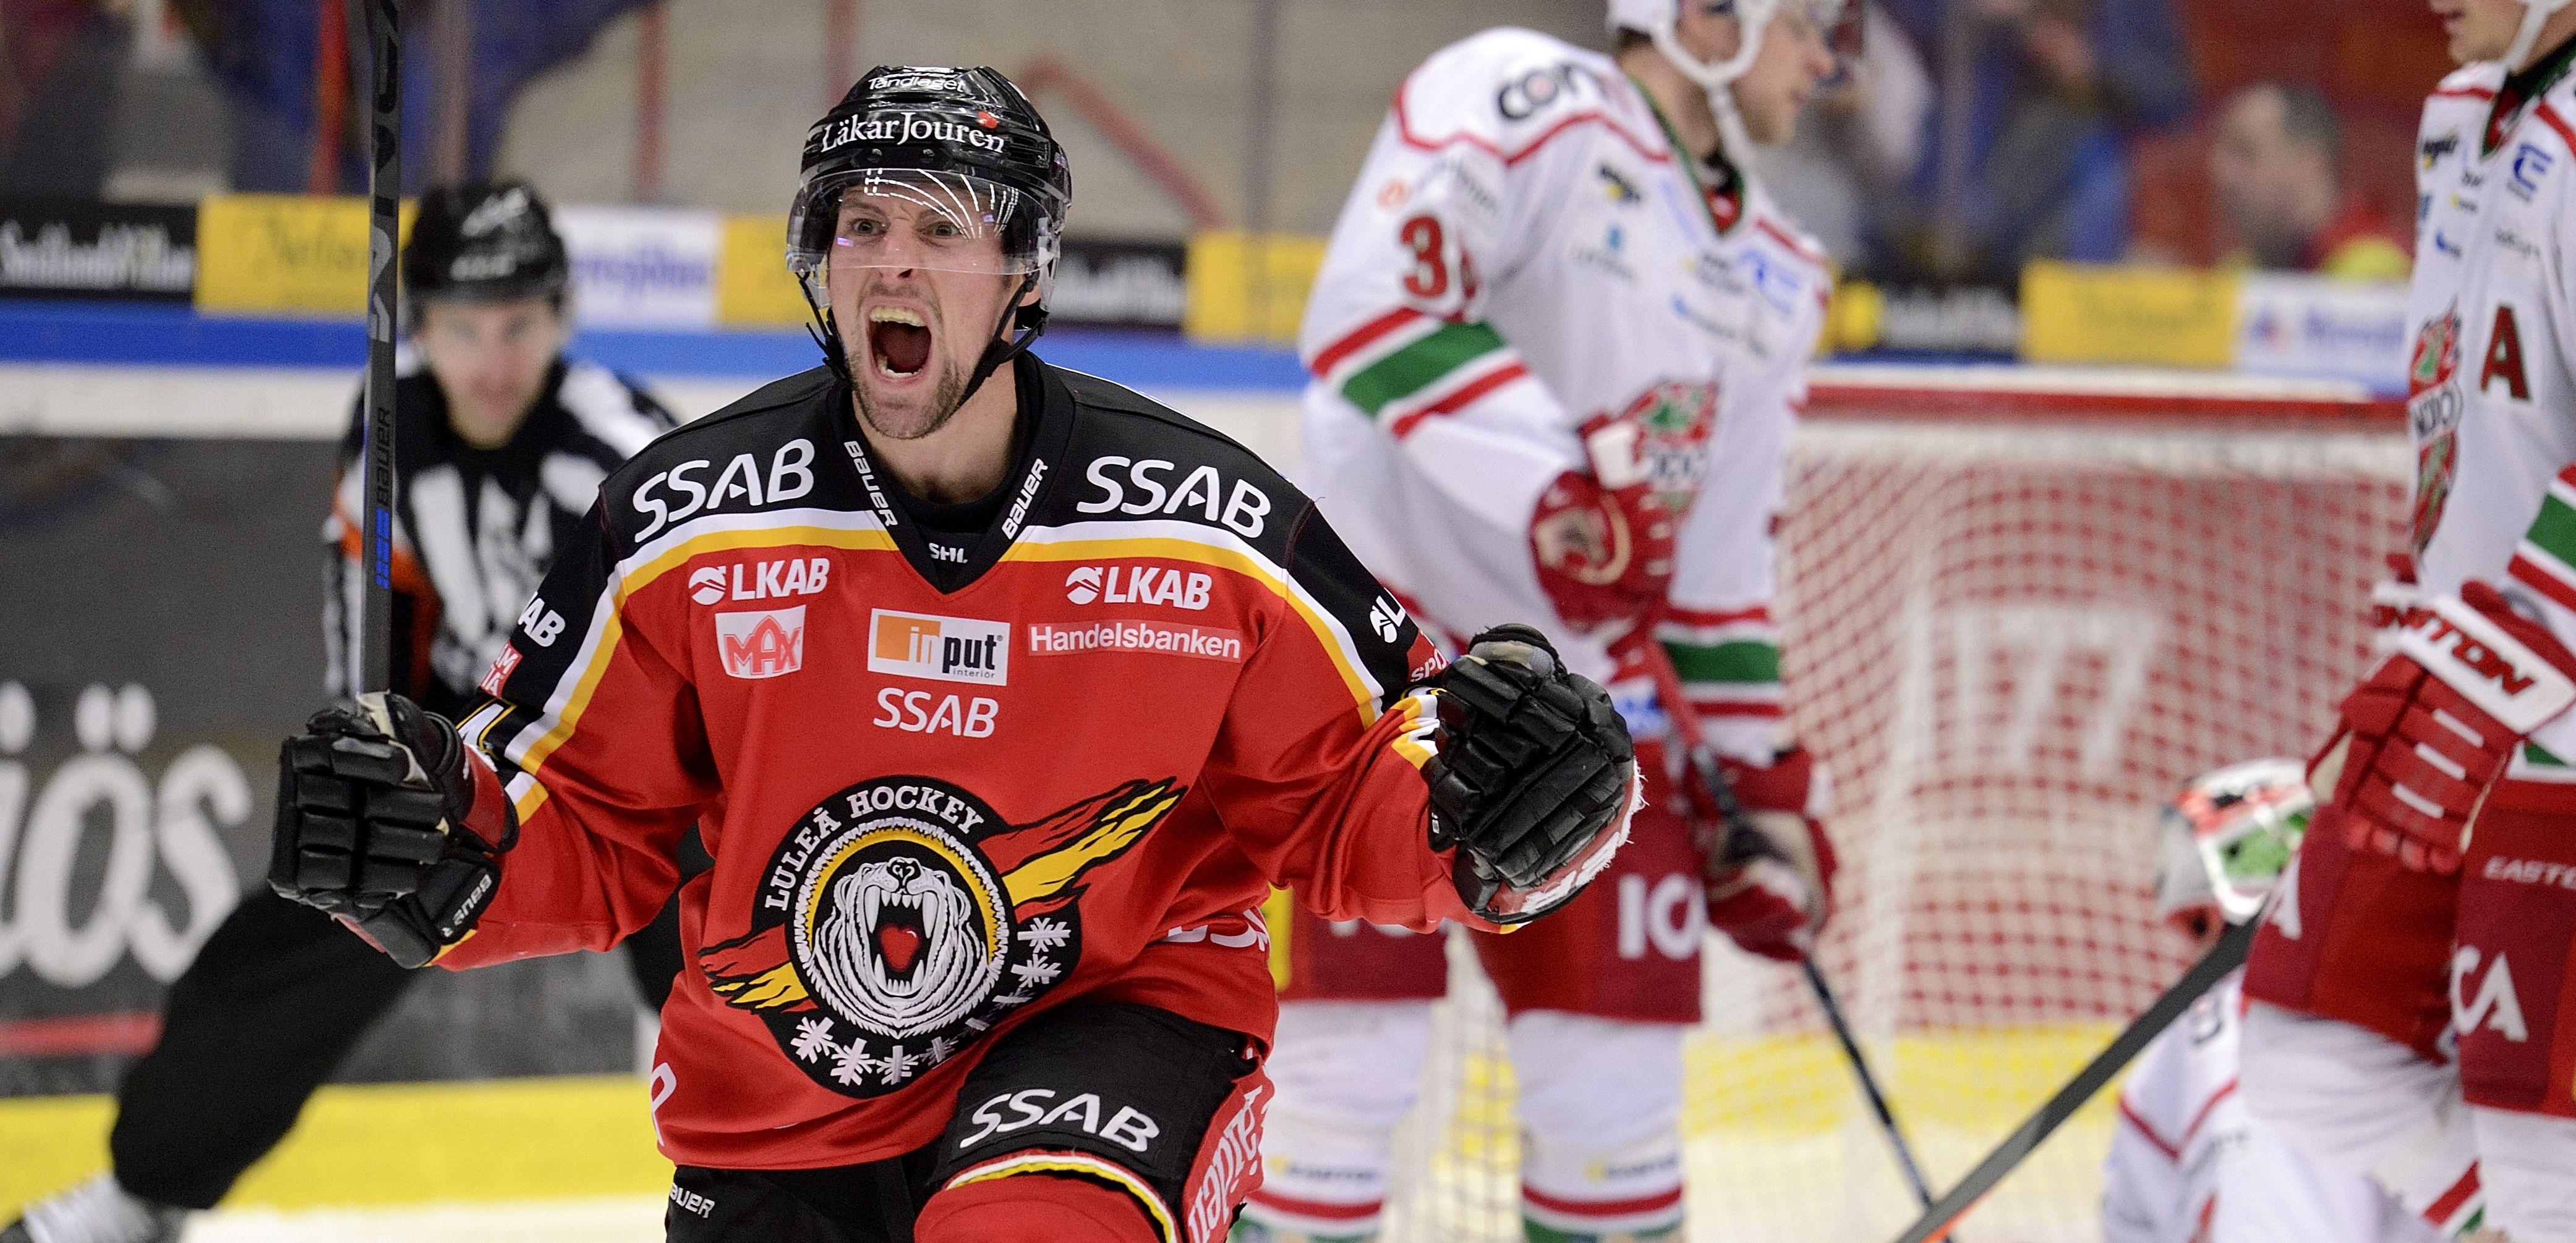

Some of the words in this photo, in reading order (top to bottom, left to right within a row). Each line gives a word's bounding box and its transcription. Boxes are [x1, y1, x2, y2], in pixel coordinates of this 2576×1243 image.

[821, 112, 1005, 154] LäkarJouren
[2480, 305, 2530, 401] A
[632, 438, 815, 543] SSAB
[843, 441, 898, 527] BAUER
[1001, 458, 1049, 540] BAUER
[1076, 456, 1271, 538] SSAB
[731, 558, 830, 601] LKAB
[928, 543, 968, 564] SHL
[1104, 566, 1213, 611] LKAB
[517, 590, 566, 647] AB
[724, 615, 802, 676] MAX
[1030, 622, 1241, 659] Handelsbanken
[909, 626, 998, 674] input
[872, 687, 1000, 739] SSAB
[765, 806, 842, 911] LULEÅ
[846, 785, 984, 834] HOCKEY
[960, 1088, 1160, 1152] SSAB
[670, 1183, 715, 1219] AUER
